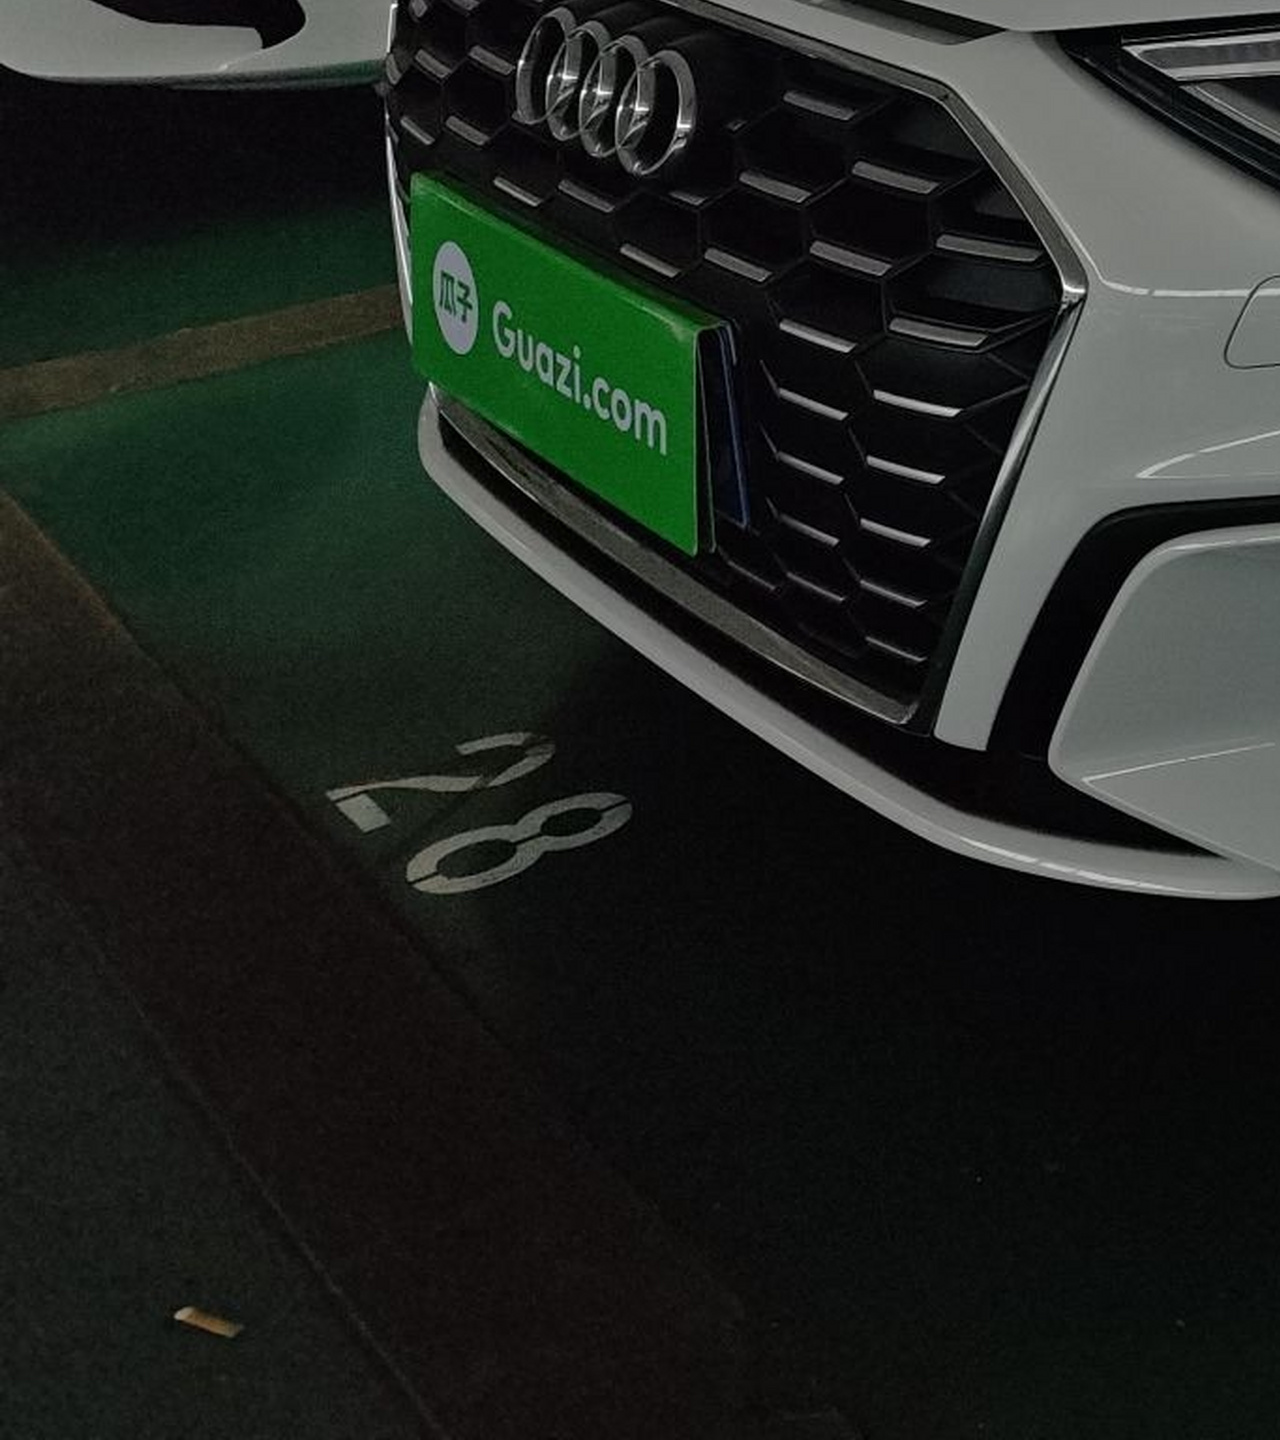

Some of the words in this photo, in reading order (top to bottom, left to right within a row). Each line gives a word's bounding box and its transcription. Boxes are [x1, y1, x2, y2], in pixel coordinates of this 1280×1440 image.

[438, 269, 473, 324] 瓜子
[492, 299, 667, 457] Guazi.com
[325, 731, 633, 895] 28
